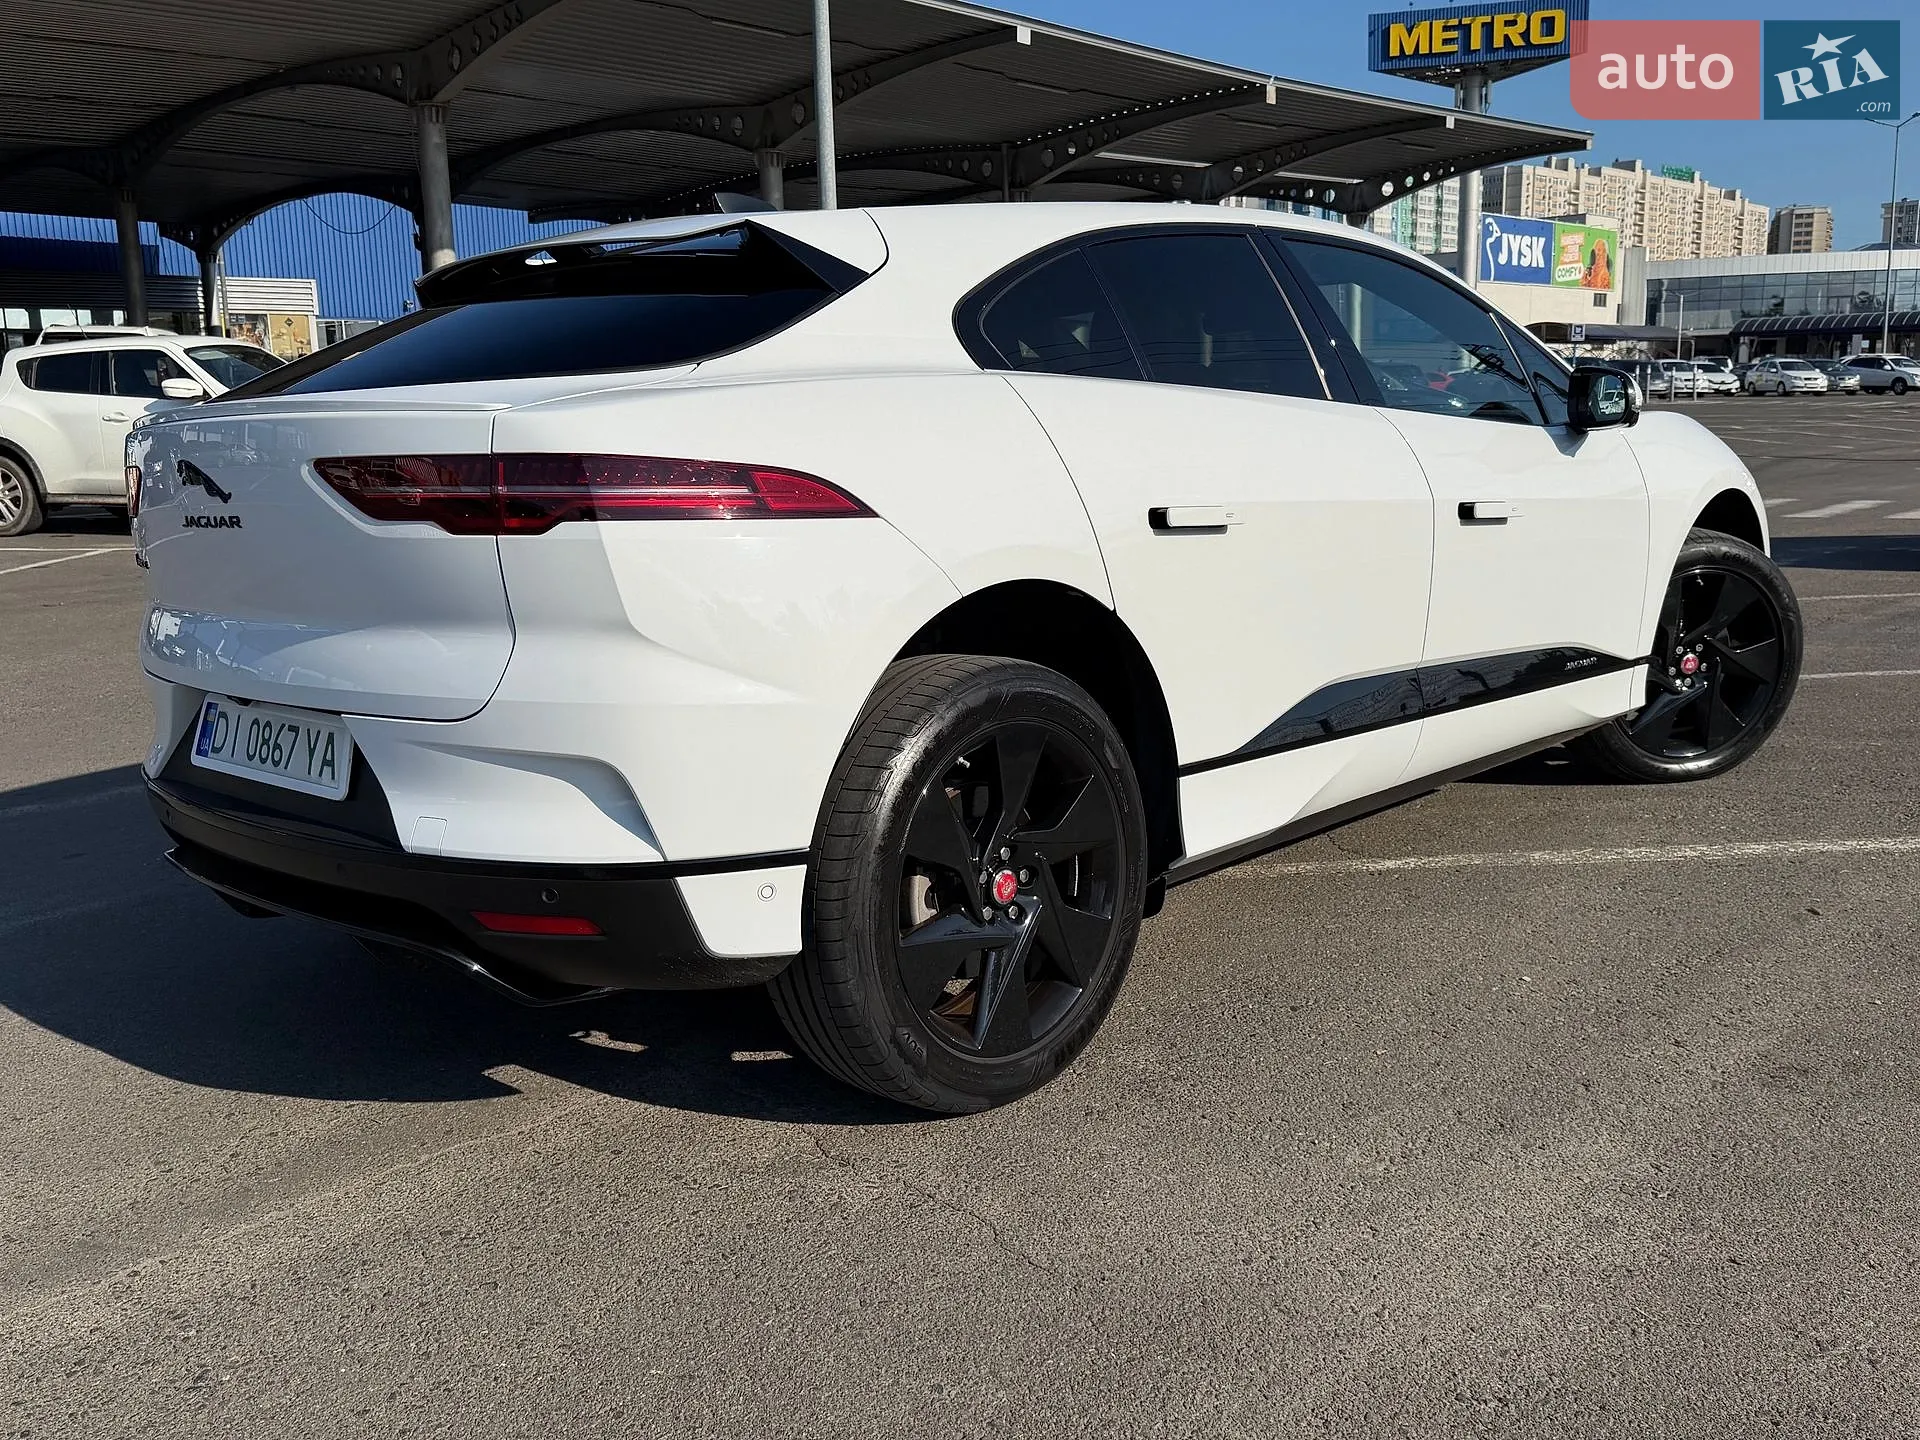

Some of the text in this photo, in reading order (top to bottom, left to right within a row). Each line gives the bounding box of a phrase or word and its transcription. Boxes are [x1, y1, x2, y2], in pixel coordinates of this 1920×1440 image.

[1389, 9, 1567, 57] METRO
[1498, 232, 1546, 268] JYSK
[182, 515, 242, 529] JAGUAR
[200, 738, 209, 750] UA
[211, 711, 336, 781] DI 0867 YA
